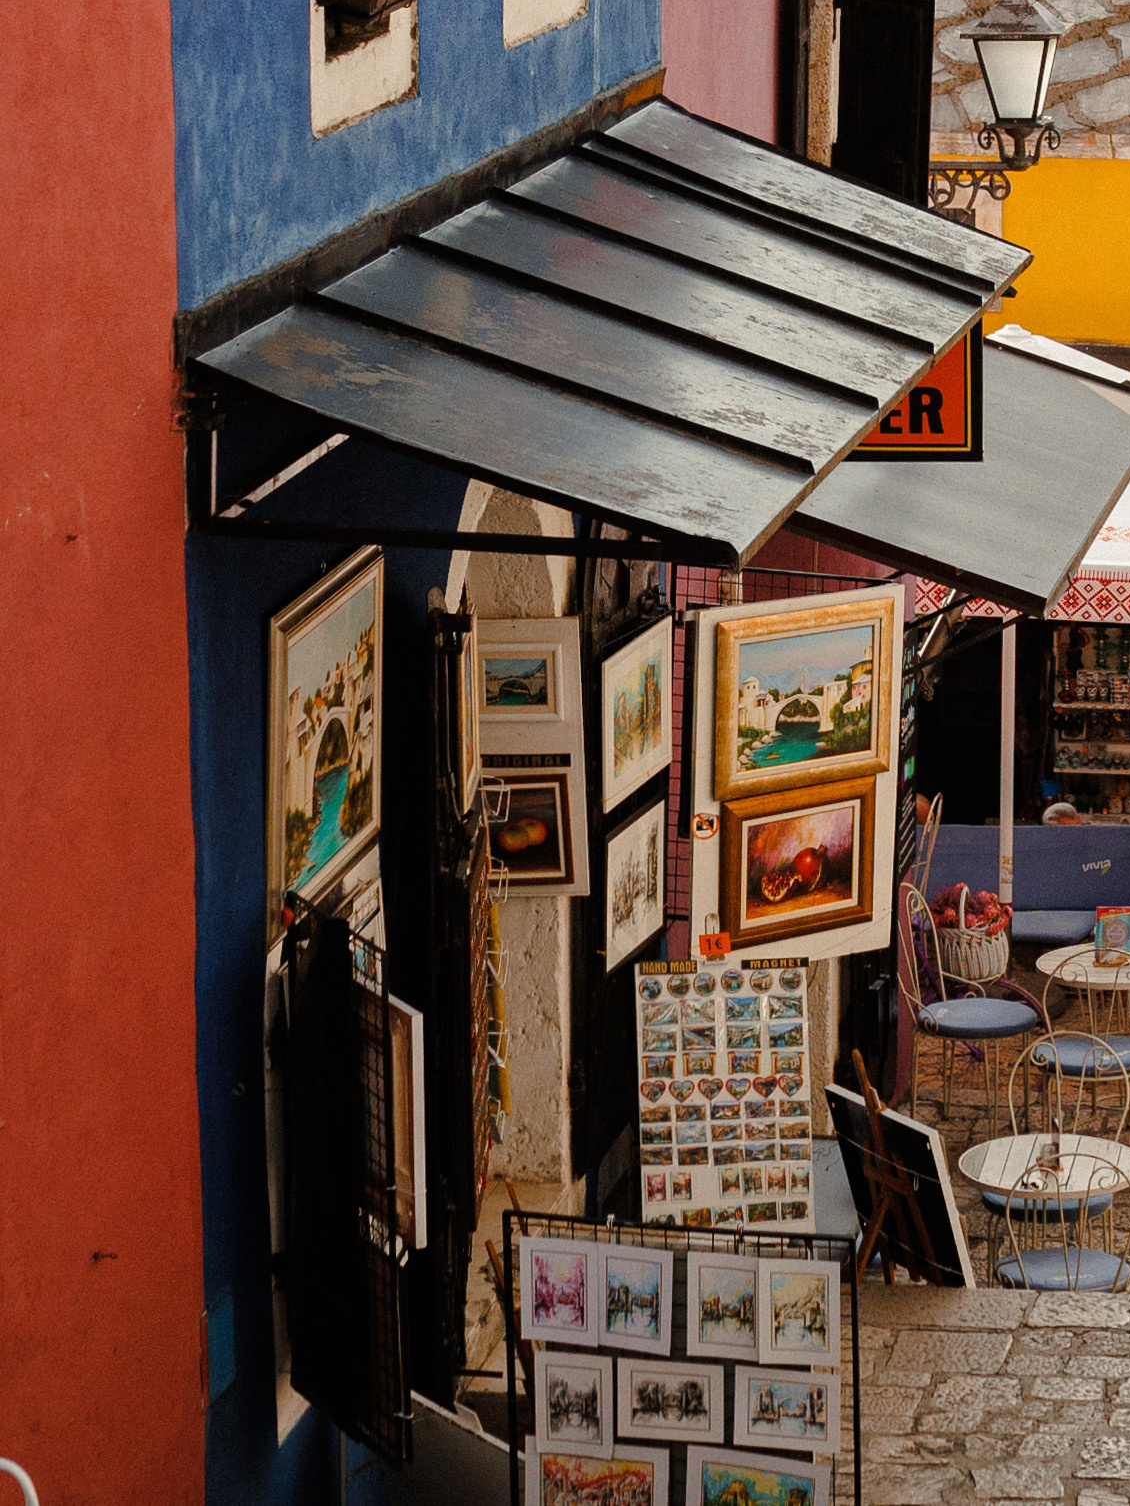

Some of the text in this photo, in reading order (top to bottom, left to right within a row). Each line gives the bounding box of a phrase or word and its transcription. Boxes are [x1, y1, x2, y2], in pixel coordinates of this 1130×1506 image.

[642, 960, 698, 974] HAND MADE
[750, 958, 801, 969] MAGNET
